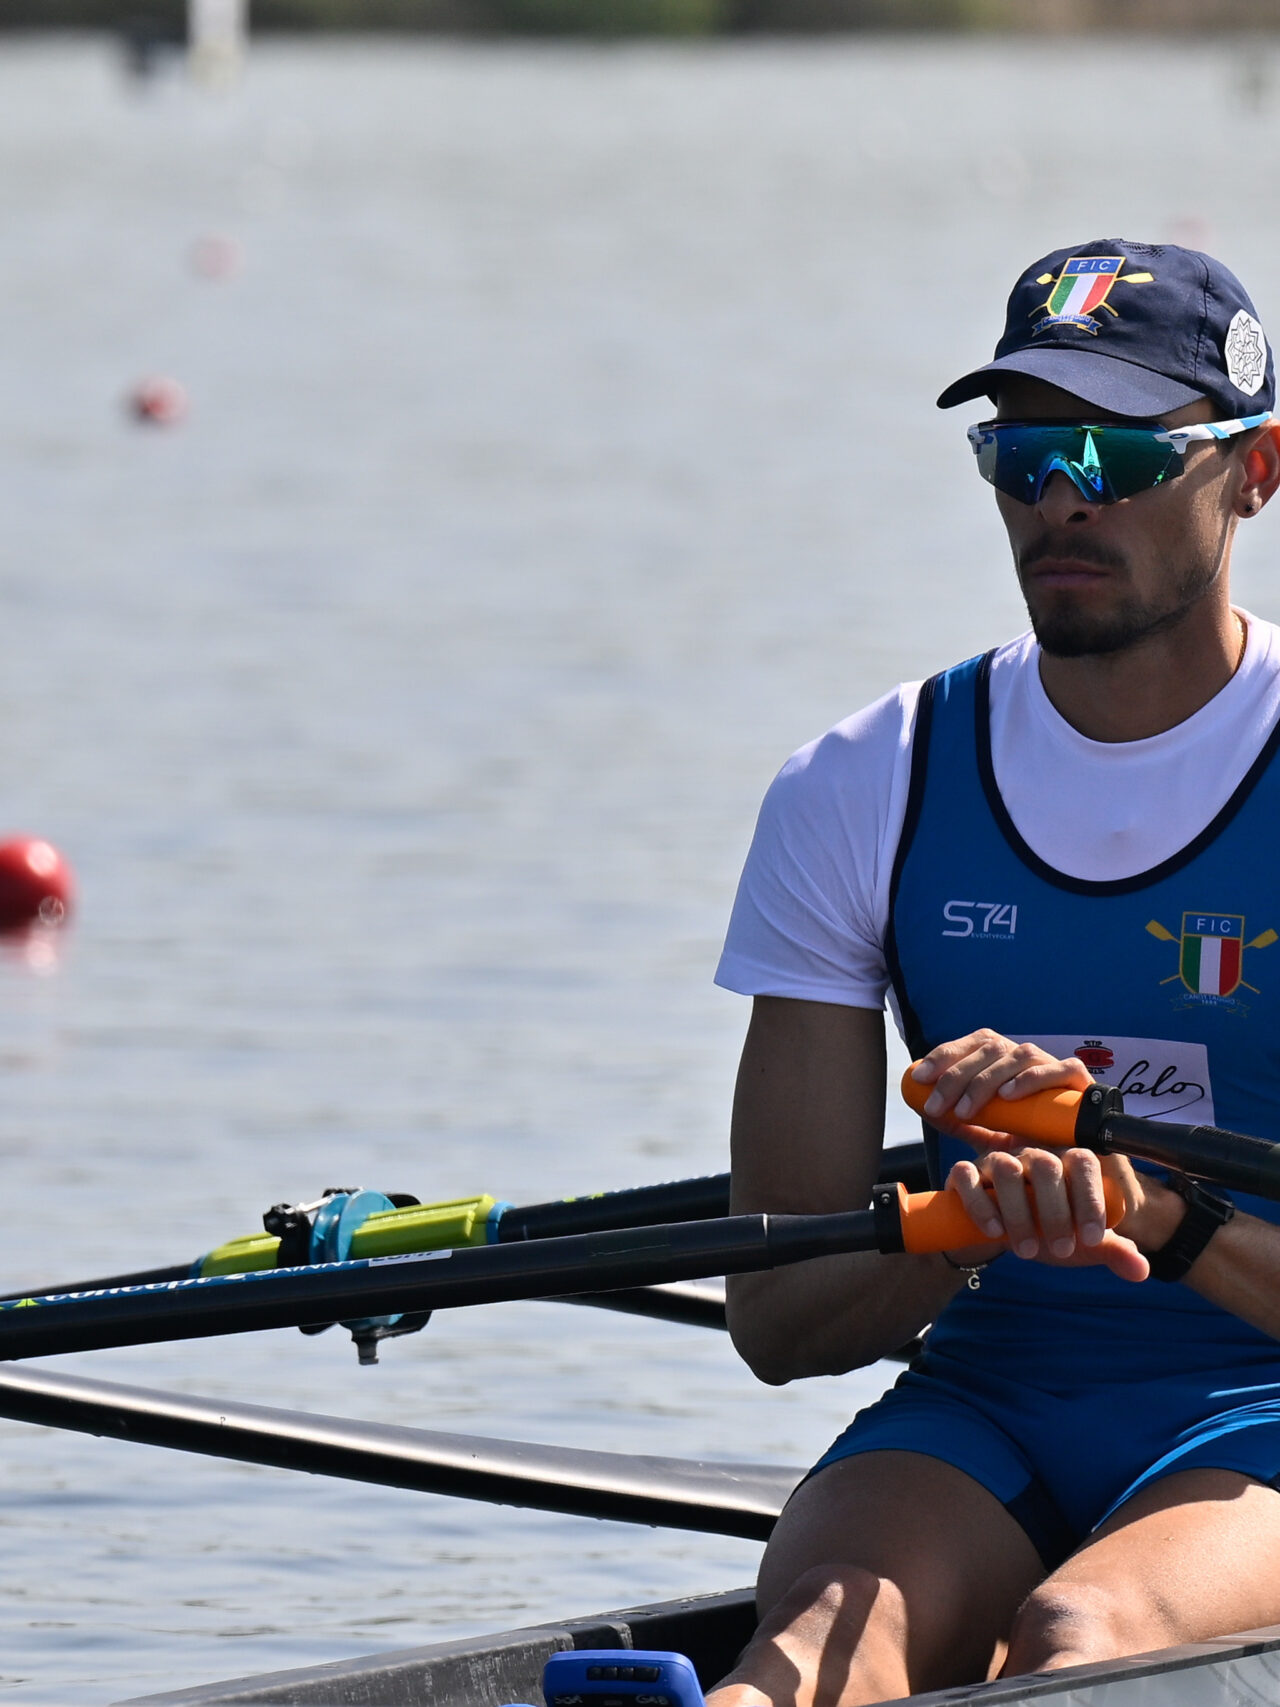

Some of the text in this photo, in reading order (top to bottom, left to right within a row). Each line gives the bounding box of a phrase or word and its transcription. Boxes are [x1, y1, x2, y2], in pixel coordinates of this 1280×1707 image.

[1077, 261, 1111, 271] FIC
[942, 900, 1018, 937] S74
[1196, 918, 1231, 933] FIC
[45, 1276, 212, 1302] concept
[967, 1273, 981, 1290] G
